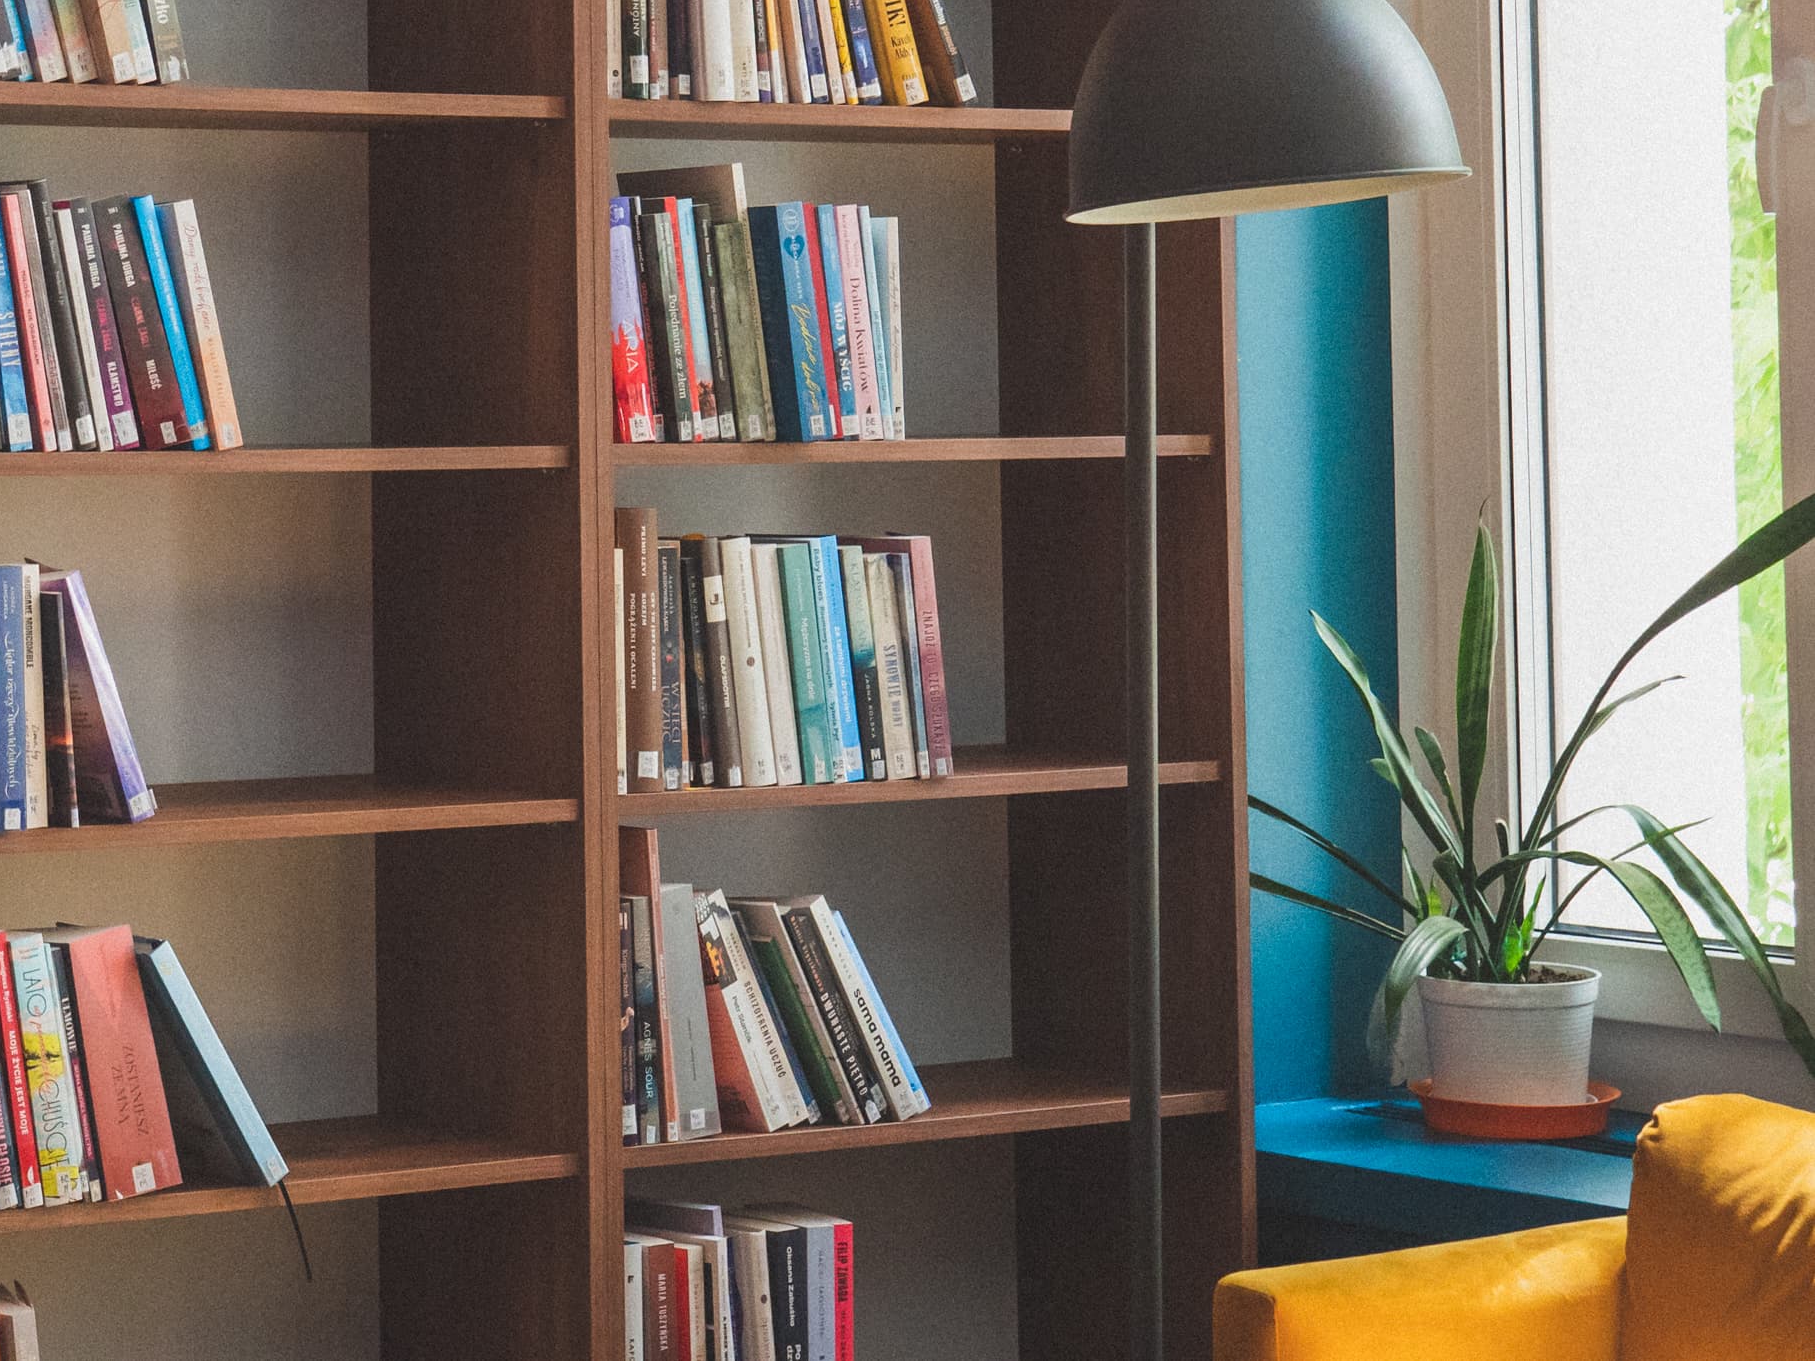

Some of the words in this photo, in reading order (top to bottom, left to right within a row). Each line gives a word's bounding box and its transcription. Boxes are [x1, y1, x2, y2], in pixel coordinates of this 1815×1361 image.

[81, 223, 96, 261] PAULINA
[88, 261, 101, 289] JURGA
[112, 223, 128, 260] PAULINA
[122, 261, 135, 288] JURGA
[145, 359, 162, 390] MIŁOŚĆ
[833, 301, 844, 332] MÓJ
[848, 276, 863, 325] Dolina
[667, 294, 683, 355] Pojednanie
[622, 318, 639, 374] ARIA
[675, 357, 684, 369] ze
[854, 329, 869, 396] Kwiatów
[106, 361, 124, 407] KŁAMSTWO
[676, 370, 688, 399] złem
[811, 547, 822, 573] Baby
[816, 574, 826, 601] blues
[628, 592, 637, 641] POGRĄŻENI
[670, 681, 679, 697] W
[883, 643, 902, 698] SYNOWIE
[671, 702, 681, 743] SIECI
[23, 969, 47, 1018] LATO
[8, 1030, 18, 1056] MOJE
[642, 1021, 652, 1061] AGNES
[743, 980, 773, 1046] SCHIZOFRENIA
[768, 1047, 785, 1078] UCZUĆ
[820, 991, 850, 1055] DWUNASTE
[845, 1054, 868, 1096] PIĘTRO
[853, 988, 877, 1033] sama
[873, 1034, 902, 1088] mama
[11, 1057, 23, 1085] ŻYCIE
[110, 1065, 124, 1082] ZE
[644, 1065, 654, 1099] SOUR
[14, 1086, 24, 1108] JEST
[121, 1044, 149, 1137] ZOSTANIESZ
[18, 1109, 29, 1135] MOJE
[786, 1246, 794, 1283] Oksana
[657, 1273, 666, 1301] MARIA
